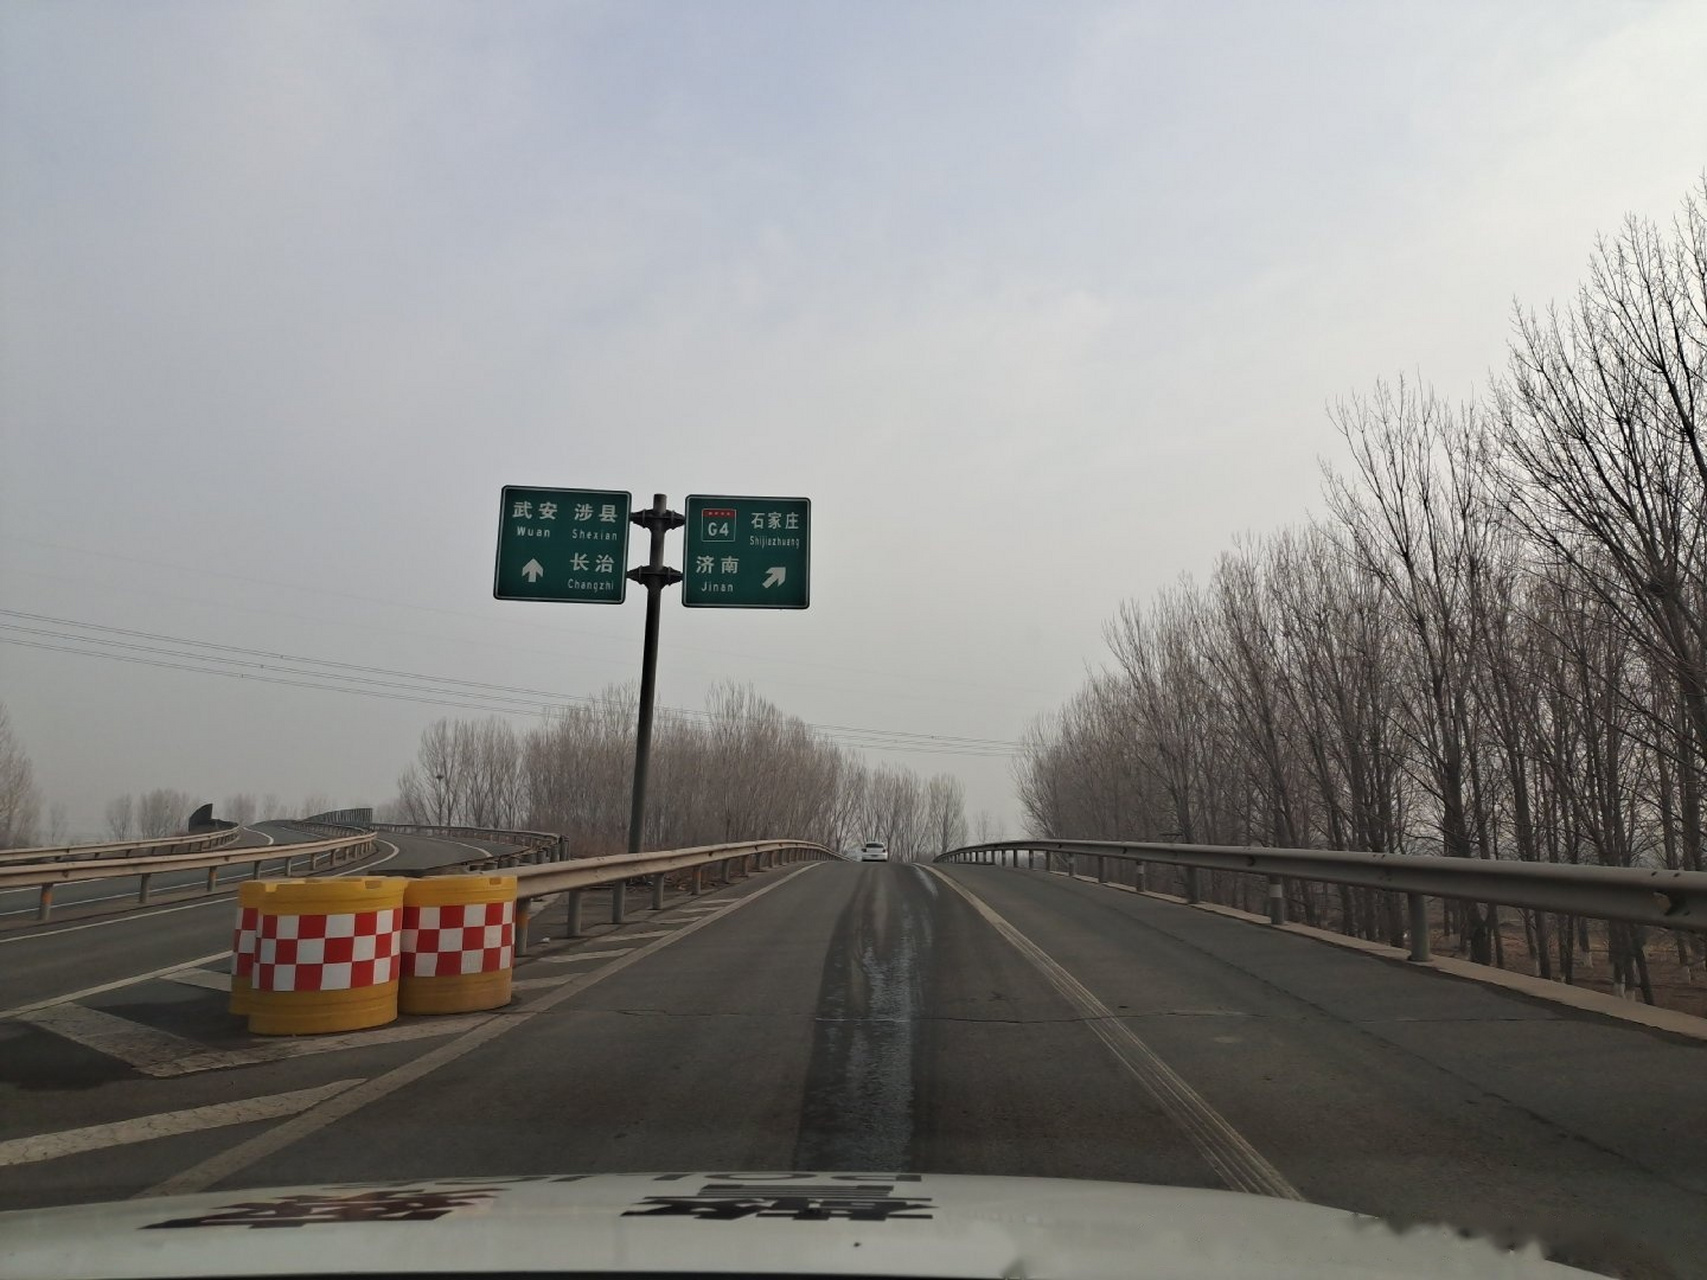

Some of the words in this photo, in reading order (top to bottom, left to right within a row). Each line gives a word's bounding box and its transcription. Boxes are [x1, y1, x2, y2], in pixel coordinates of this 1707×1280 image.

[513, 501, 558, 520] 武安
[574, 503, 618, 523] 涉县
[750, 511, 800, 530] 石家庄
[517, 526, 550, 537] Wuan
[572, 529, 617, 541] Shexian
[708, 521, 730, 537] G4
[570, 552, 614, 573] 长治
[695, 555, 740, 575] 济南
[568, 578, 614, 592] Changzhi
[701, 582, 734, 593] Jinan
